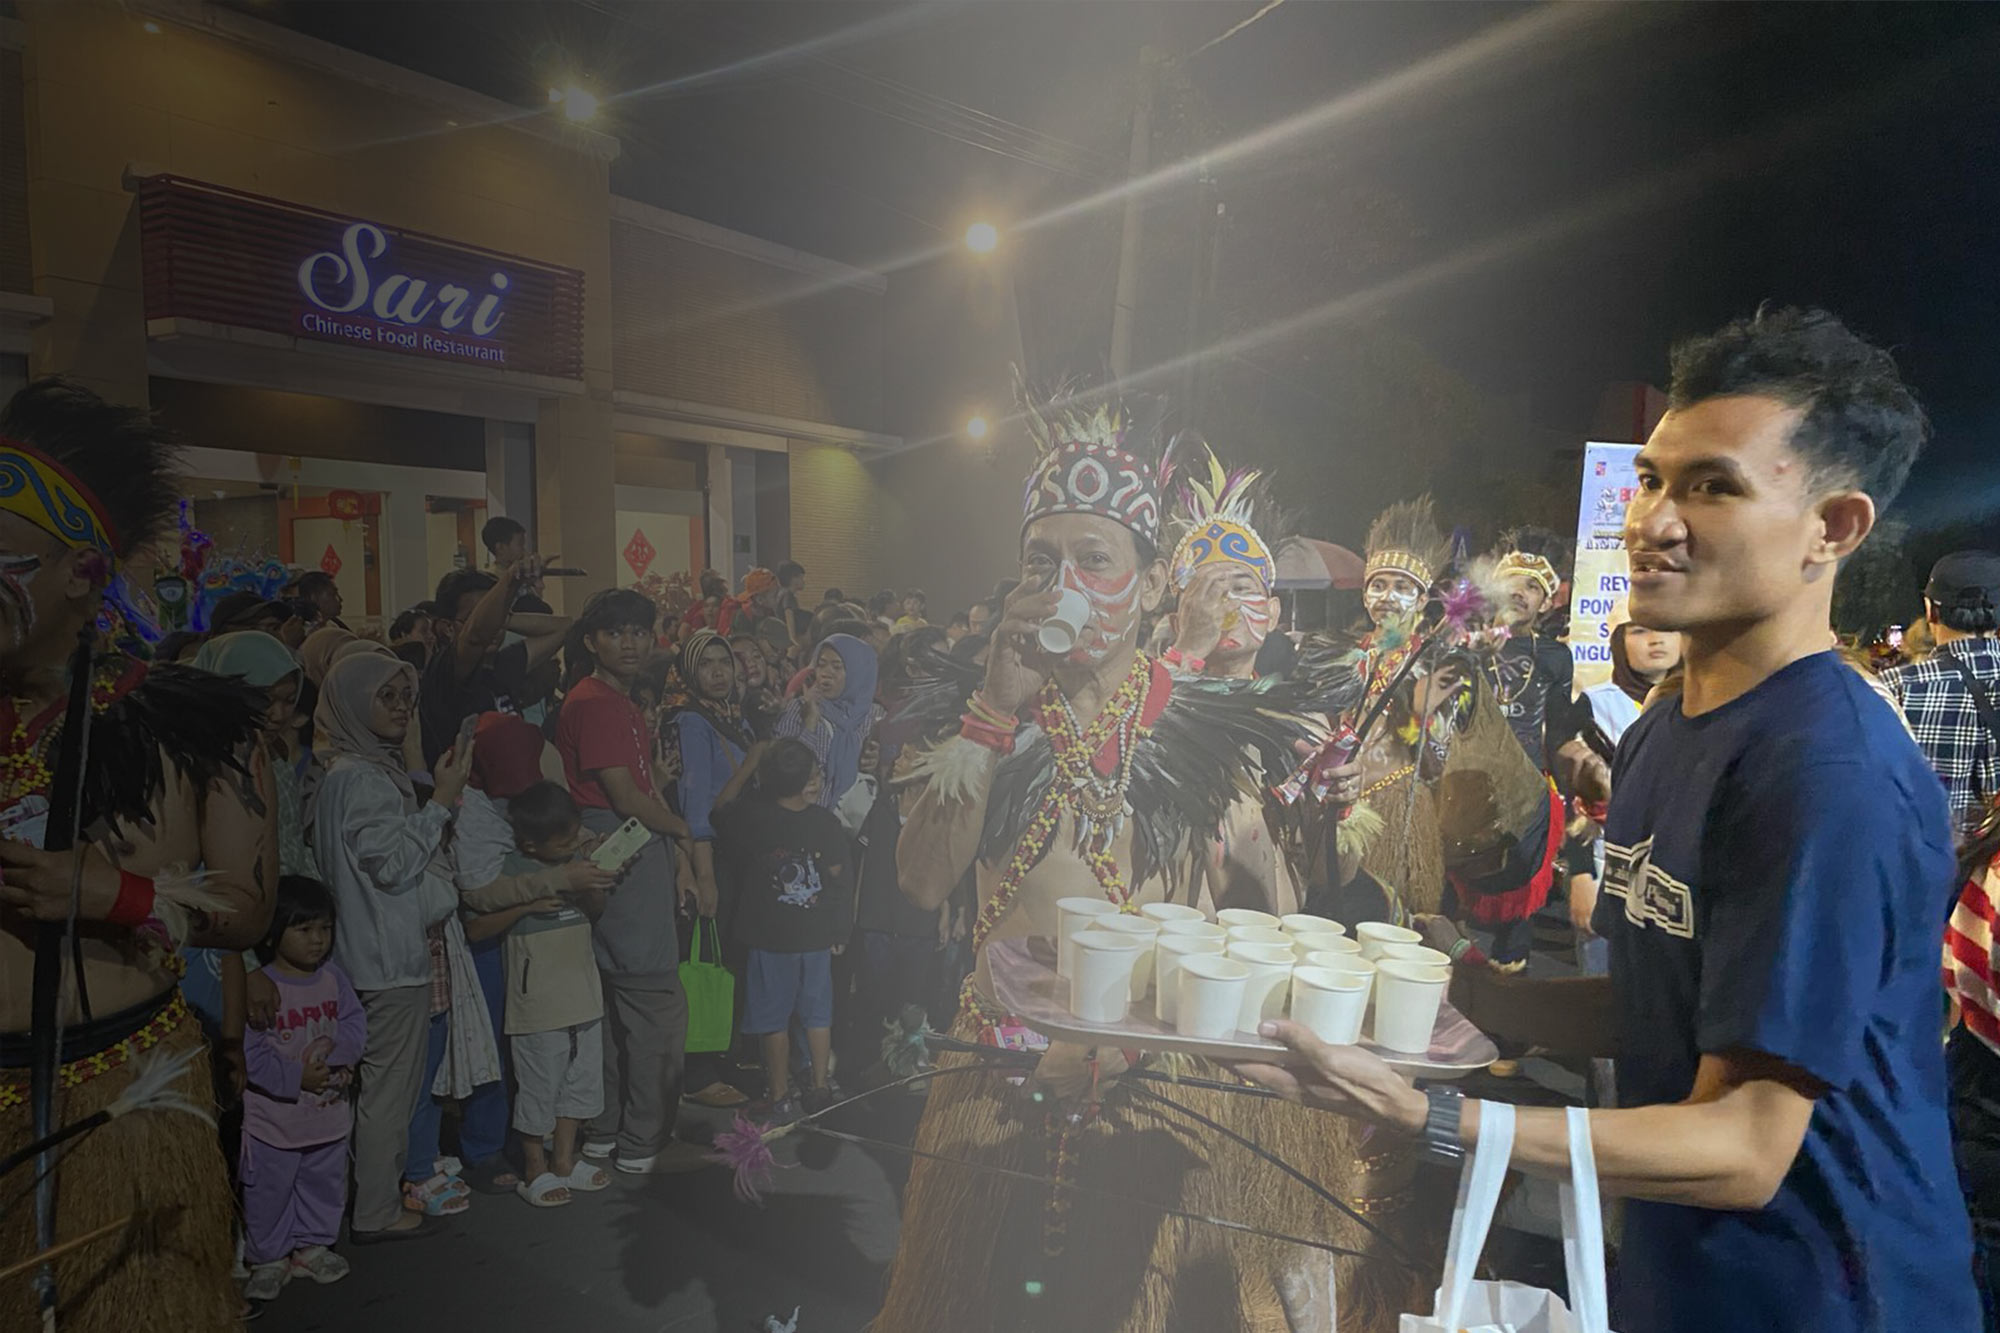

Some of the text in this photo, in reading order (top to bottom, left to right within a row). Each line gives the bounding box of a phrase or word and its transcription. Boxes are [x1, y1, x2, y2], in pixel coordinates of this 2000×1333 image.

[298, 223, 508, 336] Sari
[301, 313, 505, 362] Chinese Food Restaurant
